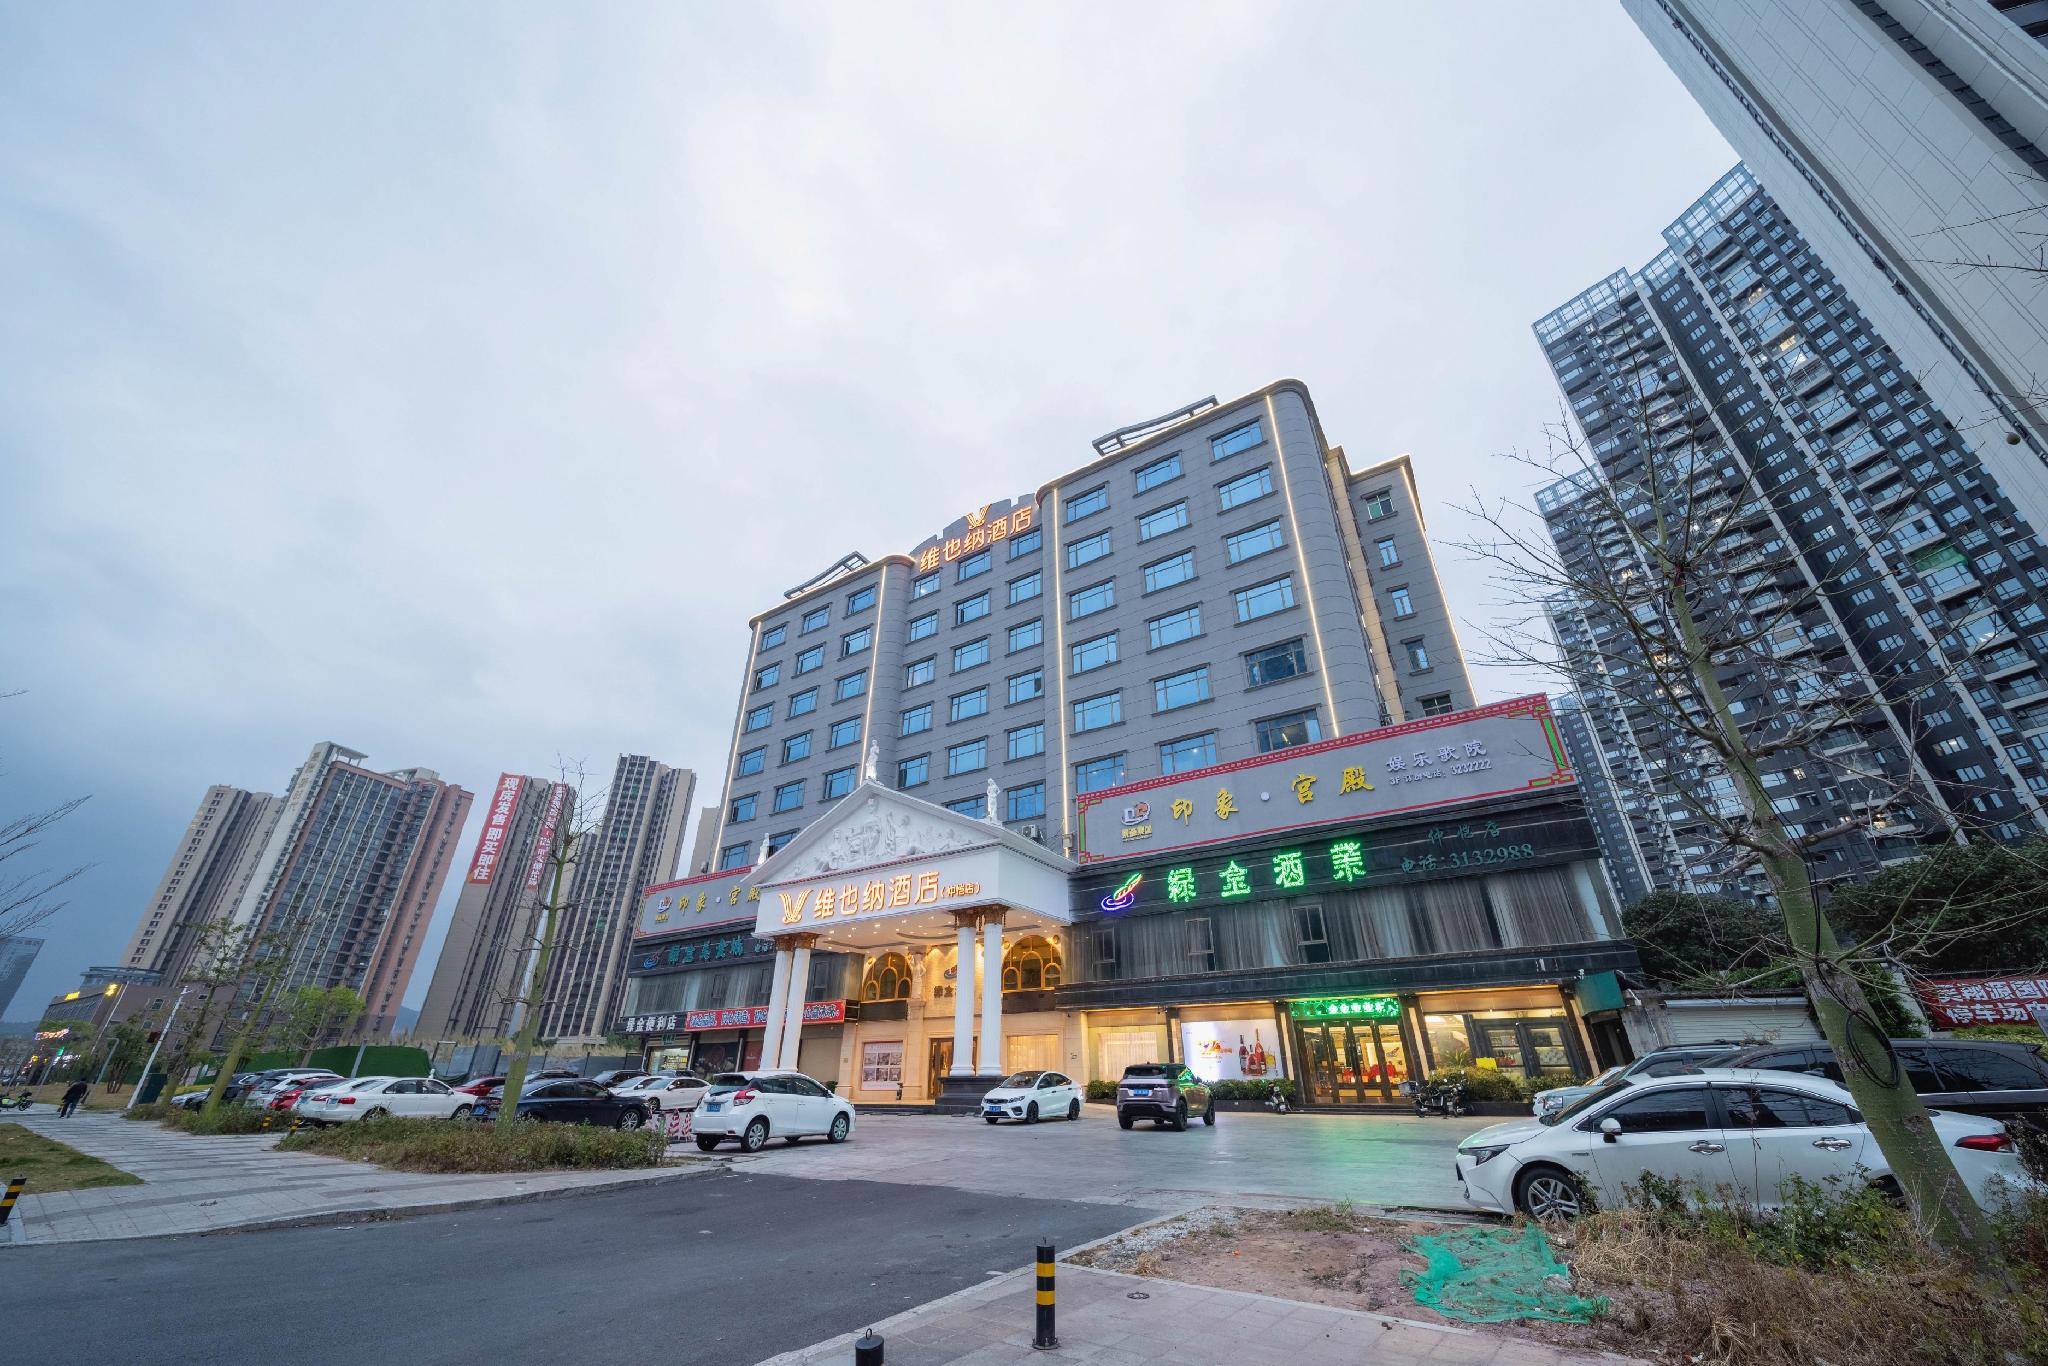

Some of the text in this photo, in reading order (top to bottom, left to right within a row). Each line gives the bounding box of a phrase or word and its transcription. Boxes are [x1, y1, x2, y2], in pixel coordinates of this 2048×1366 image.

[920, 506, 1032, 572] 维也纳酒店
[1386, 739, 1487, 772] 娱乐歌院
[1451, 759, 1492, 775] 3232222
[473, 777, 519, 880] 现房发售 即买即住
[1428, 820, 1500, 848] 仲恺店
[814, 871, 939, 919] 维也纳酒店
